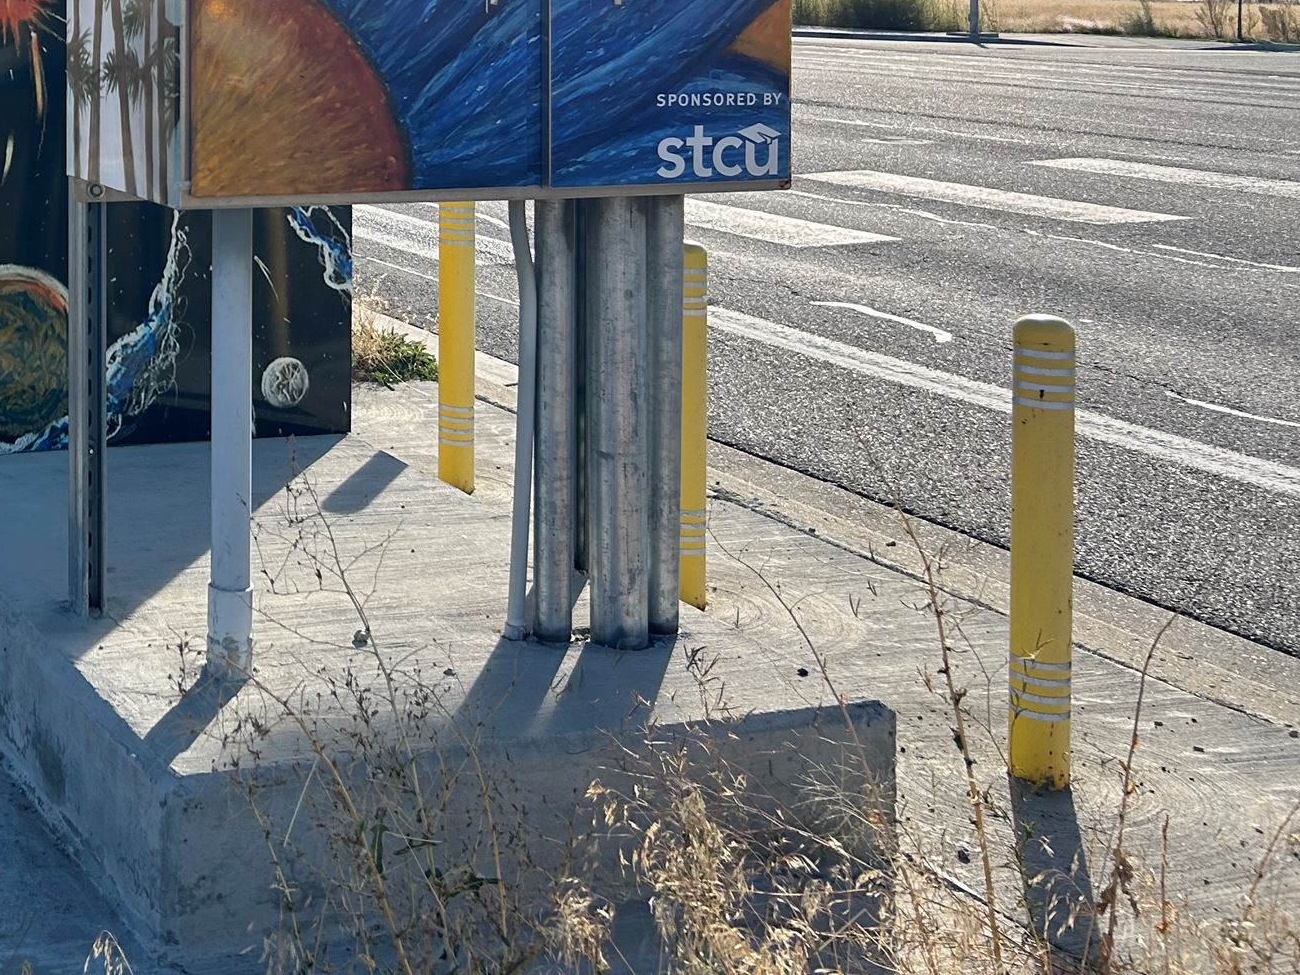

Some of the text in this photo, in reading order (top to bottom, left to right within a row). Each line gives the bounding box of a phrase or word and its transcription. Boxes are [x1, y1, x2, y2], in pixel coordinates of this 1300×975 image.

[656, 91, 782, 107] SPONSORED BY
[656, 122, 781, 178] stcu
